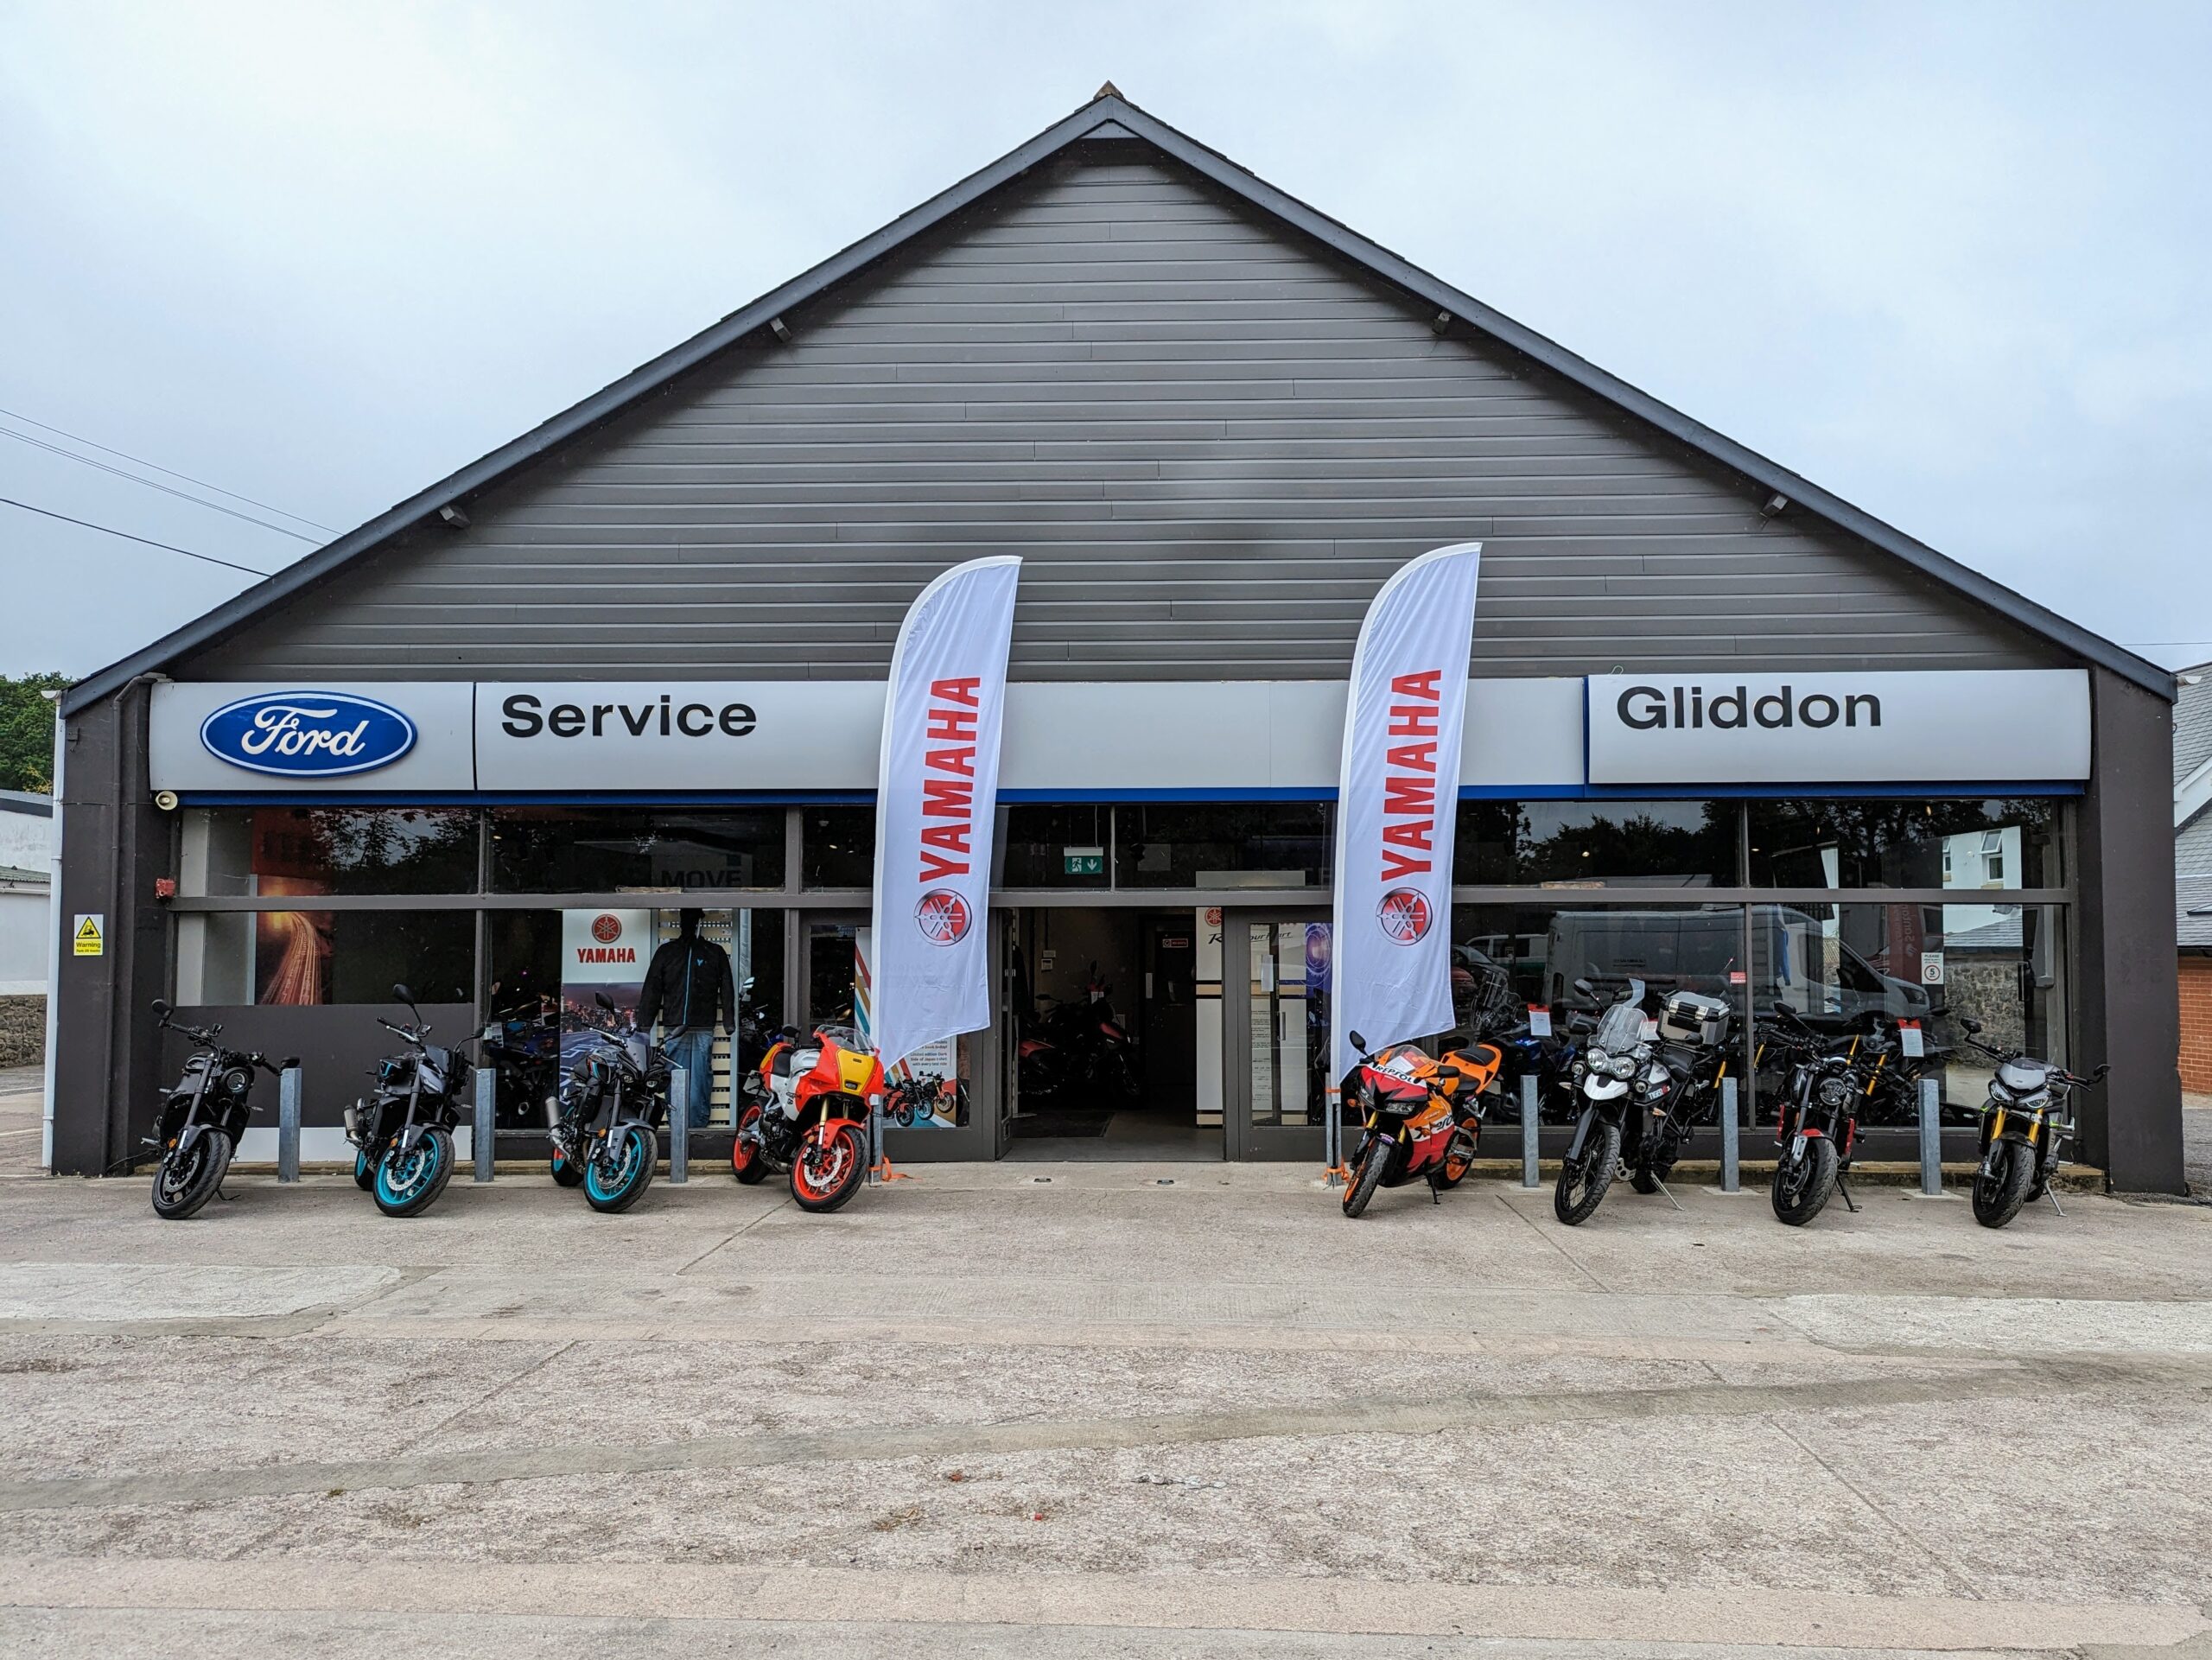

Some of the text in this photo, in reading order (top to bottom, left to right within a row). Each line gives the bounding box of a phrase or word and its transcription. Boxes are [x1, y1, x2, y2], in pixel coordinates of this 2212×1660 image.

[502, 694, 757, 737] Service
[1617, 685, 1881, 729] Gliddon
[241, 705, 370, 756] Ford
[918, 677, 981, 883] YAMAHA
[1381, 670, 1441, 881] YAMAHA
[661, 870, 741, 887] MOVE
[577, 948, 636, 964] YAMAHA
[1375, 1065, 1413, 1082] REPSOL
